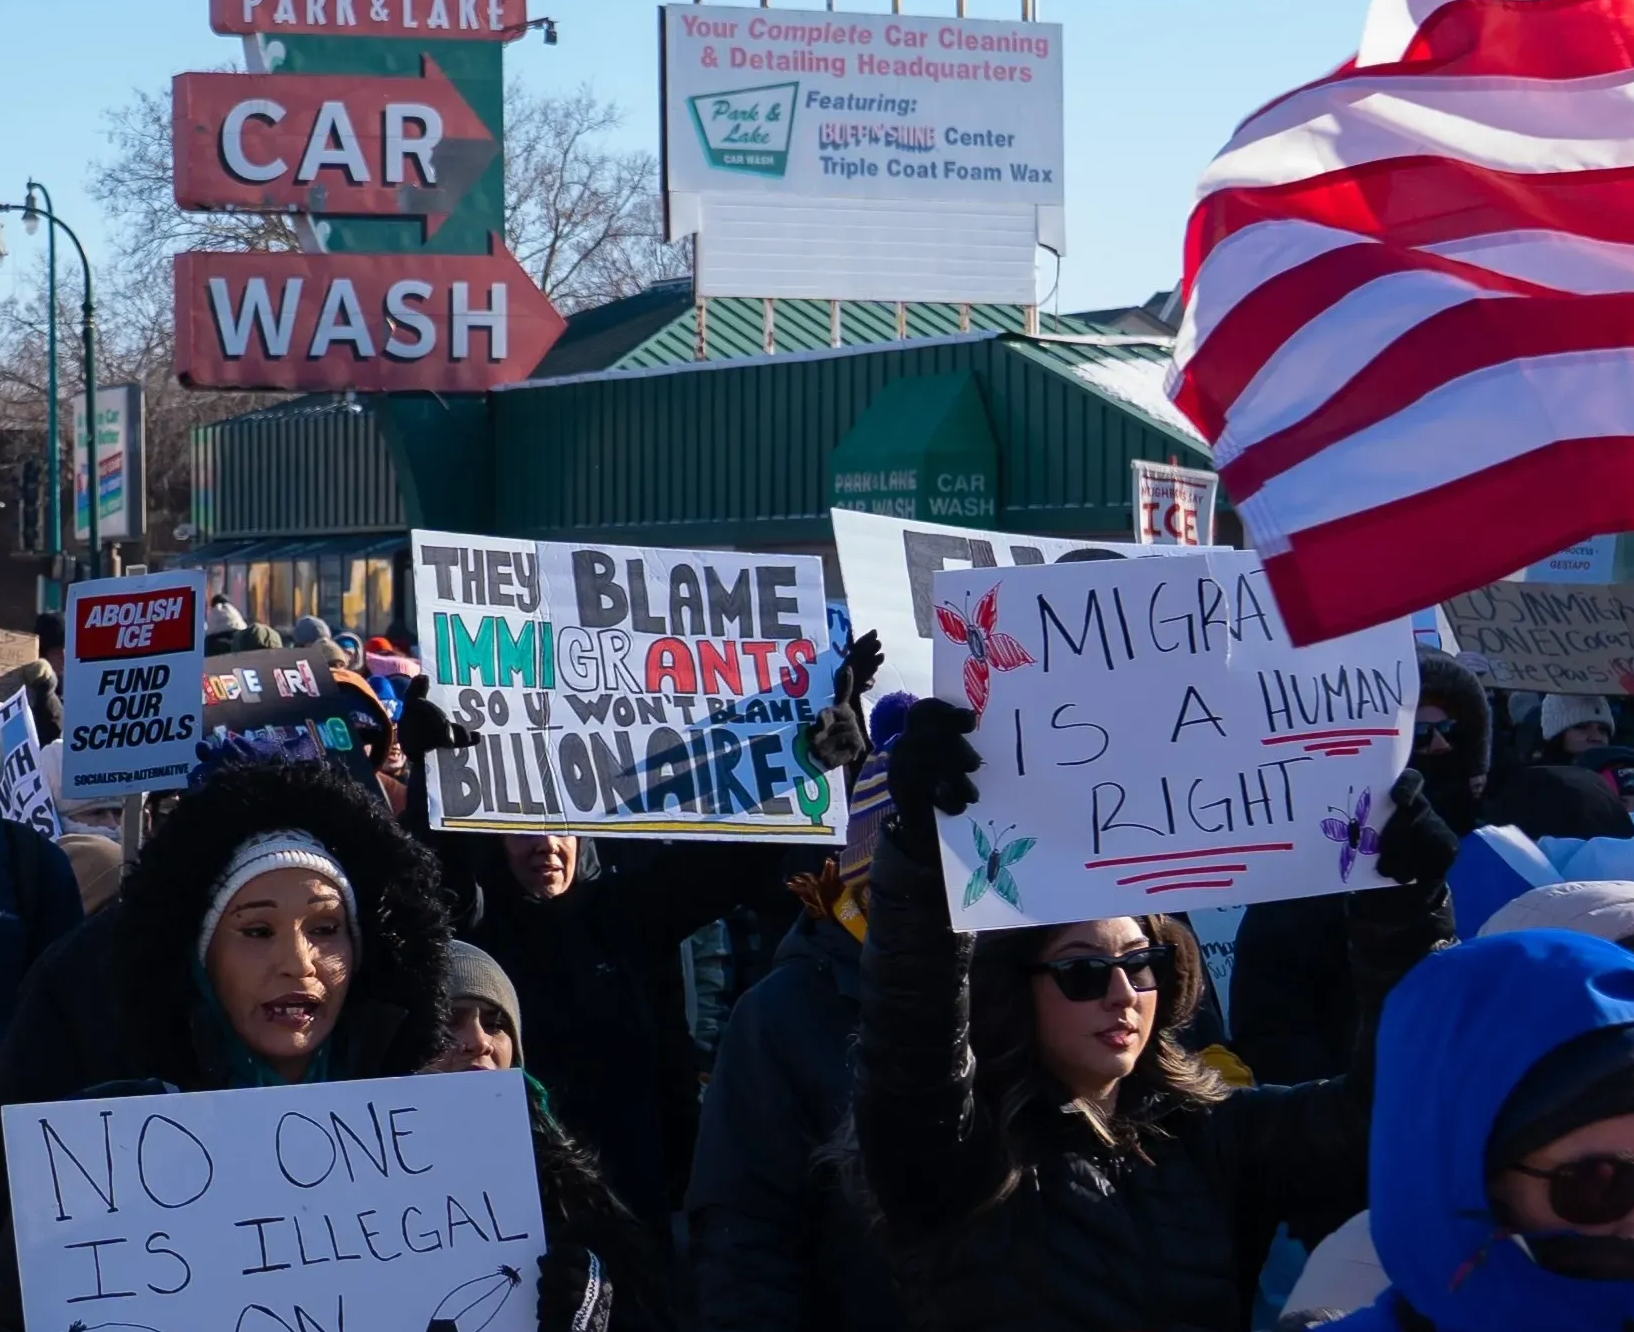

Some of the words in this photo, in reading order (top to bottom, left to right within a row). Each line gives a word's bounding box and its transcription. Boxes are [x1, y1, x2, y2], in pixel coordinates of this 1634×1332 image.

[681, 15, 738, 39] Your
[748, 18, 873, 47] Complete
[885, 25, 928, 48] Car
[938, 28, 1049, 57] Cleaning
[700, 46, 719, 67] &
[730, 47, 846, 78] Detailing
[857, 54, 1033, 83] Headquarters
[711, 100, 759, 121] Park
[765, 102, 781, 122] &
[805, 90, 918, 116] Featuring:
[221, 99, 445, 187] CAR
[720, 123, 771, 144] Lake
[944, 127, 1016, 148] Center
[723, 155, 744, 164] CAR
[819, 155, 878, 179] Triple
[886, 159, 938, 179] Coat
[943, 161, 1002, 181] Foam
[1009, 163, 1053, 183] Wax
[208, 275, 510, 363] WASH
[937, 473, 985, 493] CAR
[872, 497, 917, 519] WASH
[929, 497, 995, 517] WASH
[1142, 502, 1198, 546] ICE
[420, 544, 541, 613] THEY
[571, 550, 803, 640] BLAME
[84, 596, 183, 629] ABOLISH
[1037, 568, 1272, 673] MIGRA
[115, 623, 154, 649] ICE
[433, 612, 817, 698] IMMIGRANTS
[97, 664, 171, 696] FUND
[106, 691, 163, 722] OUR
[453, 688, 510, 727] SO
[563, 692, 698, 728] WON'T
[707, 695, 817, 725] BLAME
[1014, 701, 1110, 776] IS
[1168, 685, 1228, 745] A
[1257, 660, 1405, 733] HUMAN
[70, 714, 196, 752] SCHOOLS
[74, 771, 121, 787] SOCIALIST
[132, 763, 190, 781] ALTERNATIVE
[1091, 754, 1316, 856] RIGHT
[37, 1109, 215, 1222] NO
[275, 1100, 435, 1189] ONE
[63, 1231, 192, 1304] IS
[233, 1191, 530, 1276] ILLEGAL
